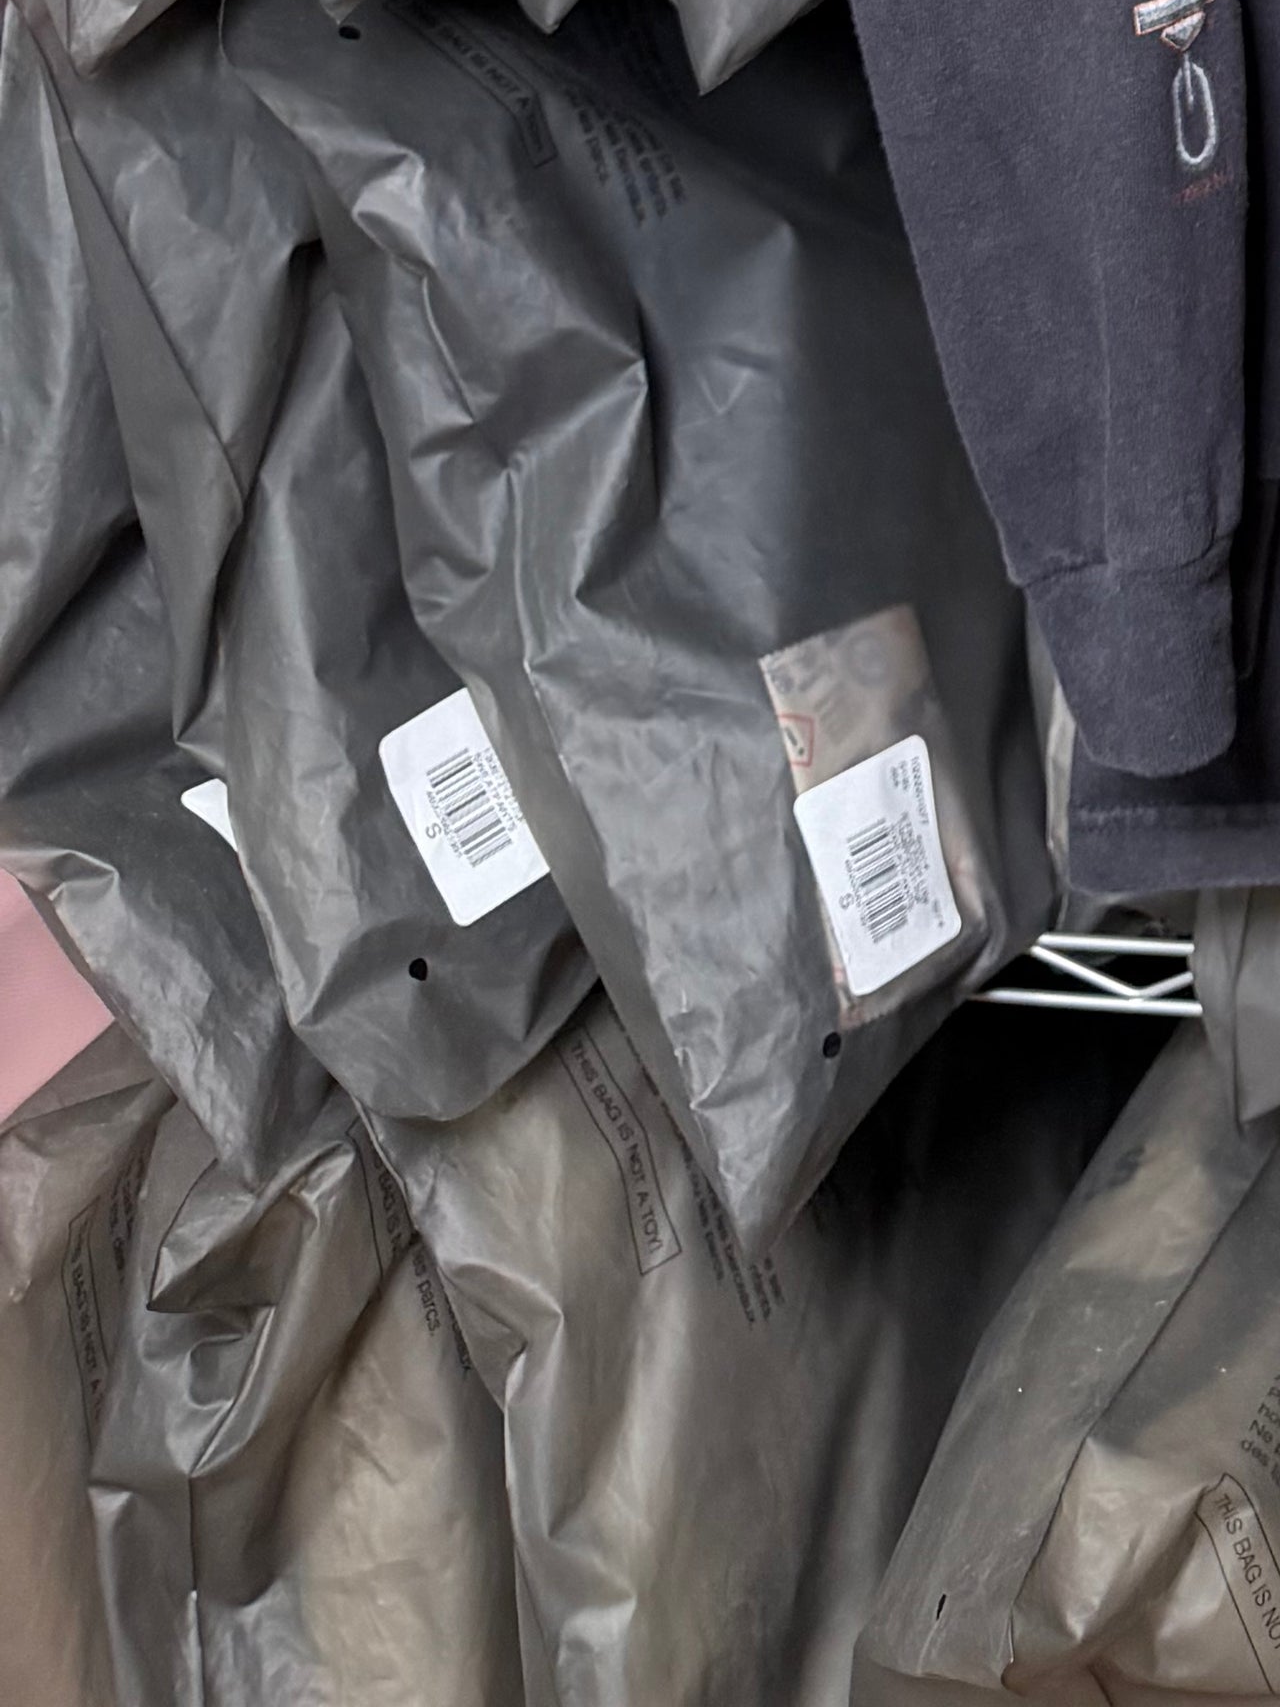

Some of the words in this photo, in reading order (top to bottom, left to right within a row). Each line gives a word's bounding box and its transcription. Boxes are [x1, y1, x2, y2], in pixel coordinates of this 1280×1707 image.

[571, 1040, 598, 1083] THIS
[593, 1084, 622, 1123] BAG
[617, 1122, 636, 1142] IS
[627, 1142, 647, 1180] NOT
[636, 1191, 650, 1208] A
[641, 1210, 664, 1255] TOY!
[417, 1279, 441, 1337] parcs.
[1250, 1419, 1272, 1444] Ne
[1240, 1440, 1270, 1467] des
[1214, 1493, 1243, 1535] THIS
[1233, 1536, 1262, 1584] BAG
[1252, 1586, 1272, 1607] IS
